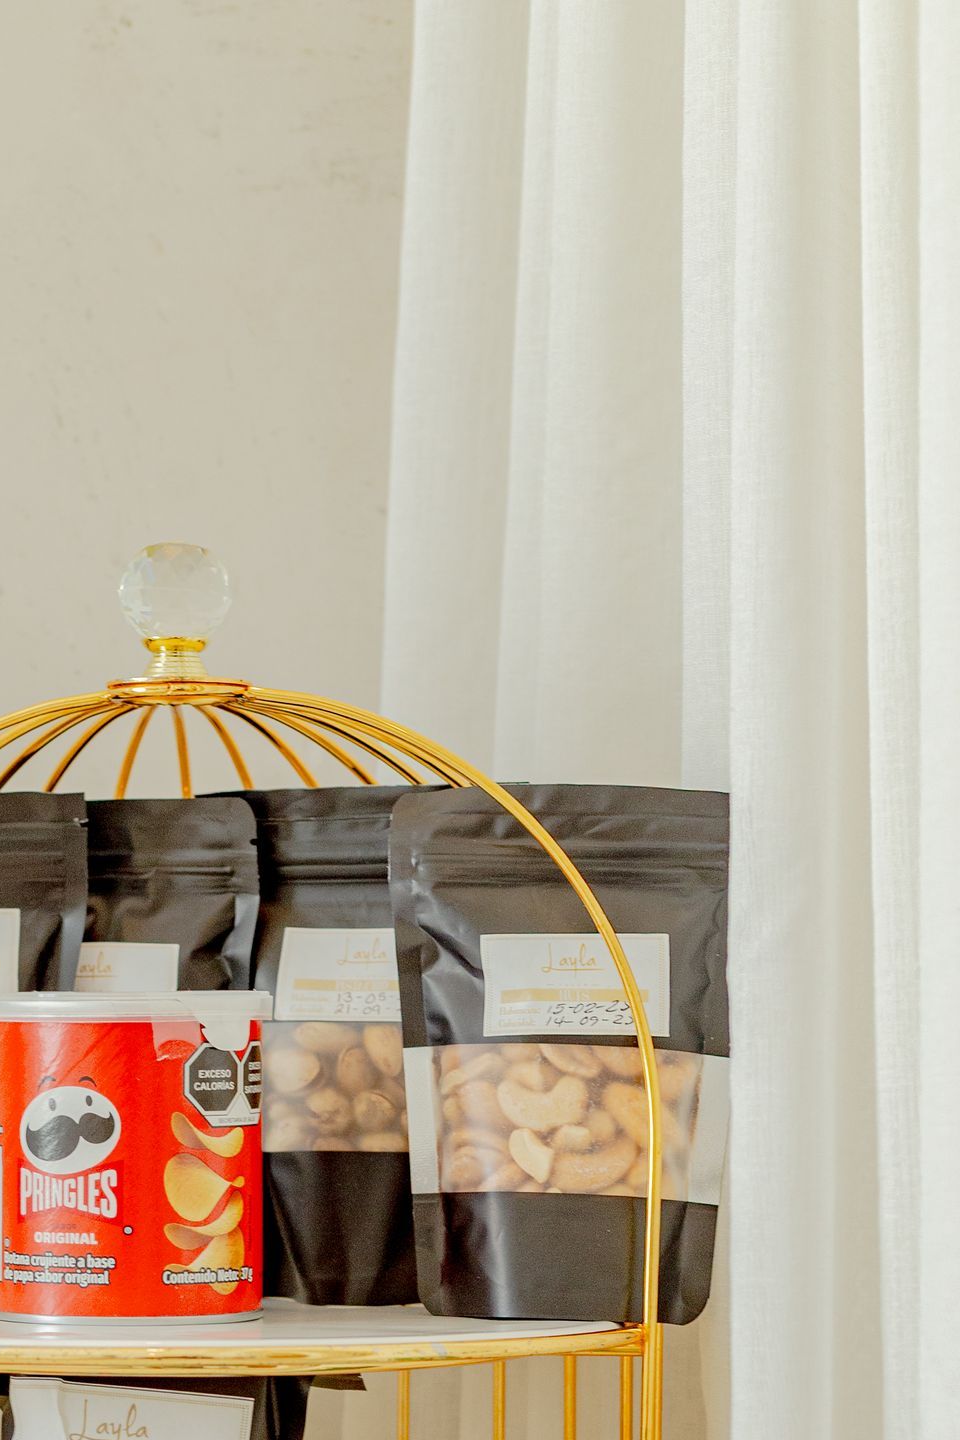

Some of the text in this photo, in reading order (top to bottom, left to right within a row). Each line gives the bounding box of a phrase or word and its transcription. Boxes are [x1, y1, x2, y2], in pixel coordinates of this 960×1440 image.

[76, 950, 118, 980] ayla
[541, 943, 605, 979] Layla
[198, 1069, 231, 1079] EXCESO
[193, 1081, 235, 1091] CALORÍAS
[20, 1167, 118, 1219] PRINGLES
[34, 1231, 98, 1245] ORIGINAL
[31, 1252, 75, 1269] crujiente
[76, 1256, 86, 1268] a
[86, 1253, 116, 1268] base
[35, 1270, 64, 1283] sabor
[64, 1271, 109, 1287] original
[162, 1268, 217, 1284] Contenido
